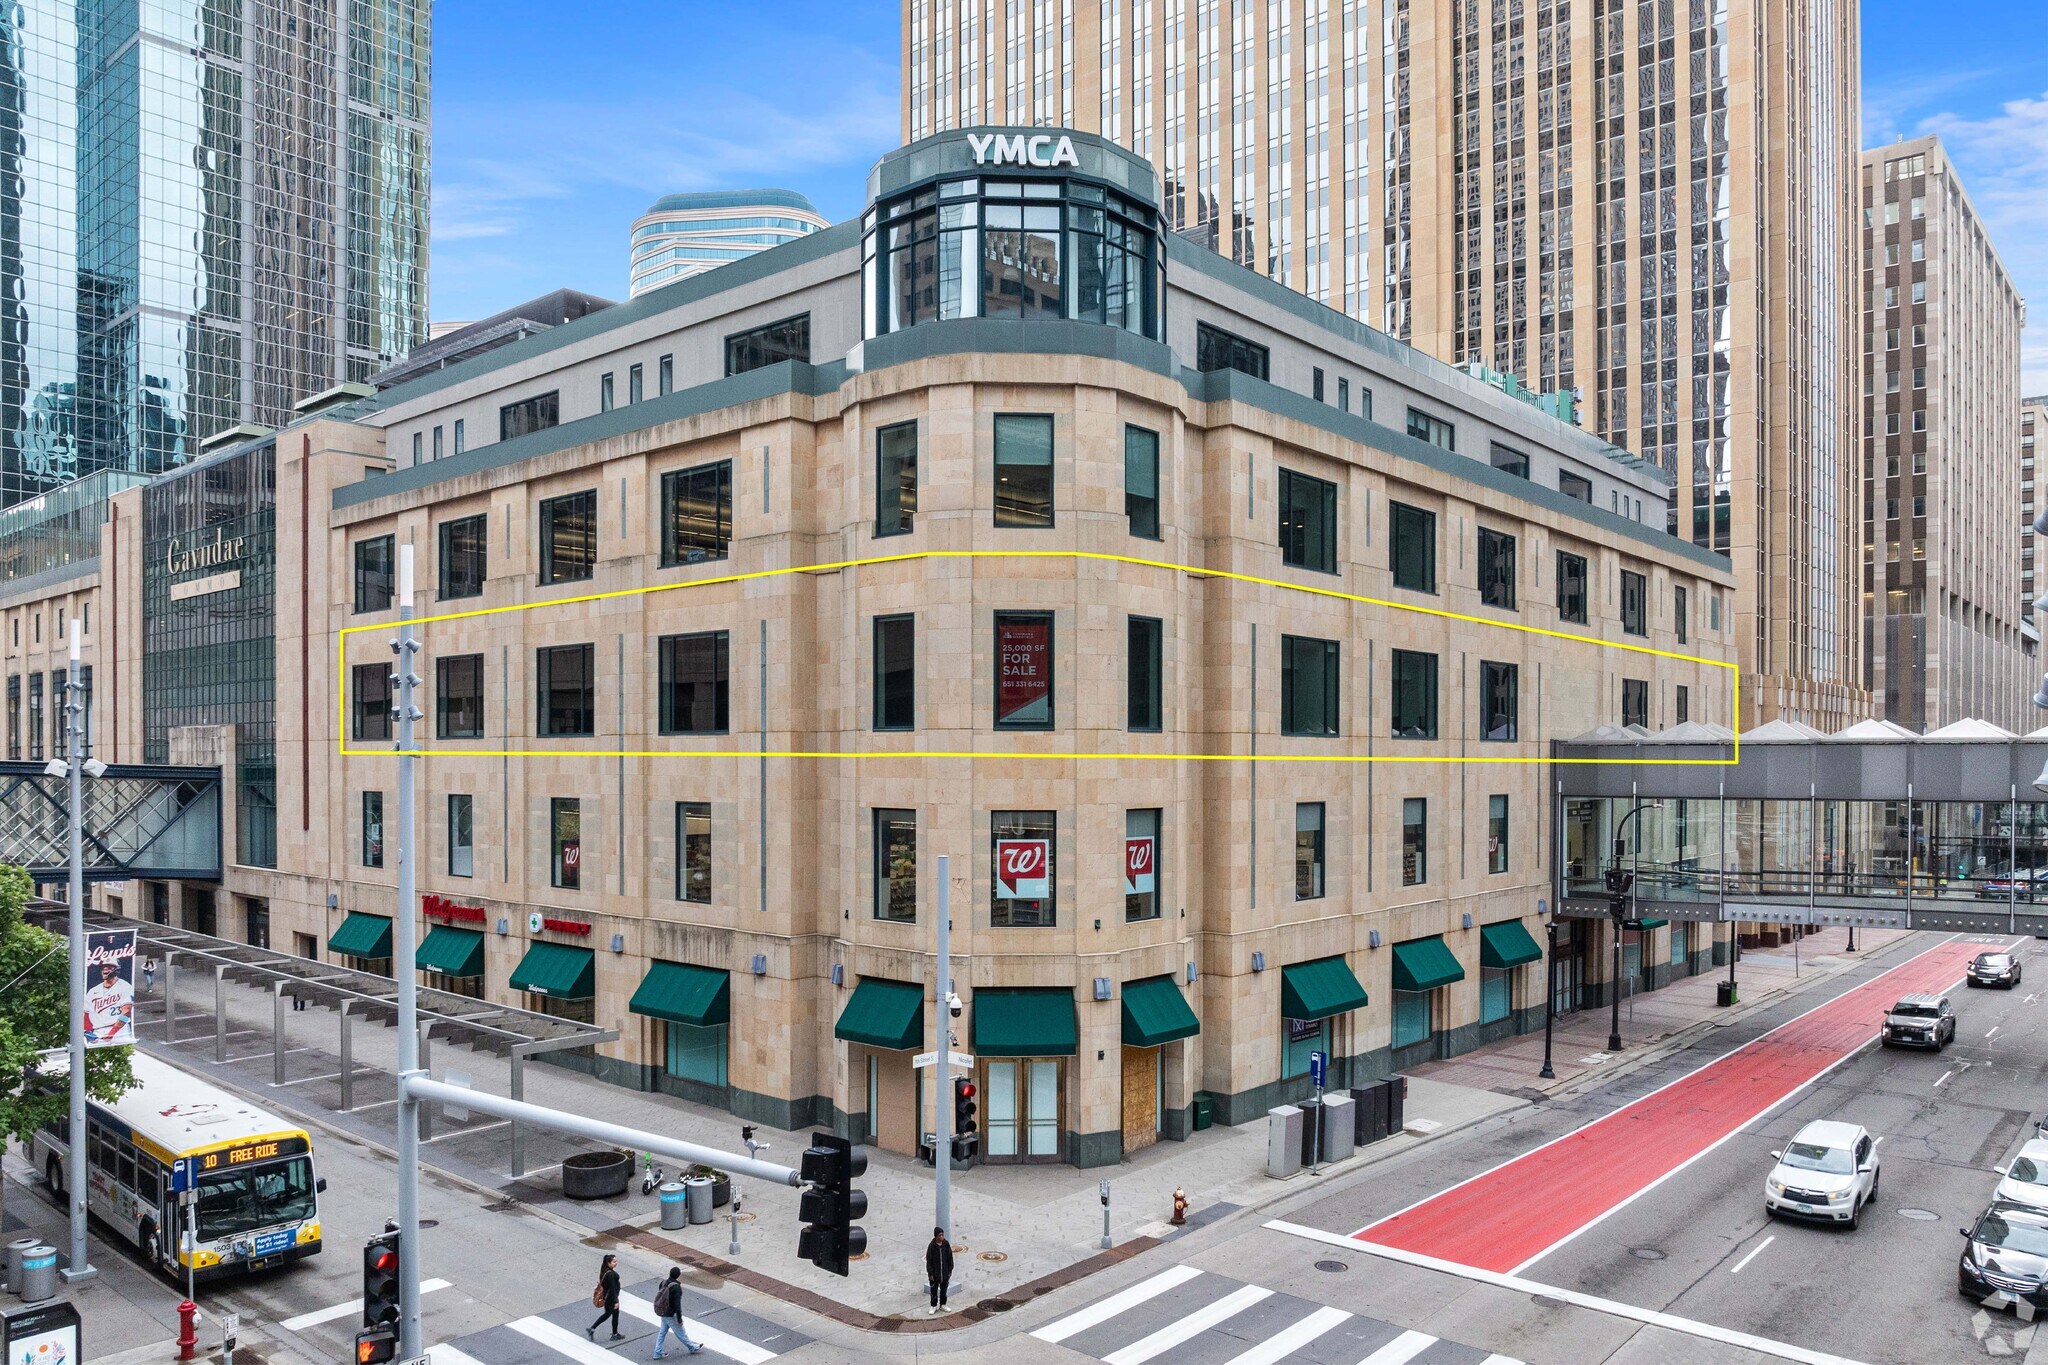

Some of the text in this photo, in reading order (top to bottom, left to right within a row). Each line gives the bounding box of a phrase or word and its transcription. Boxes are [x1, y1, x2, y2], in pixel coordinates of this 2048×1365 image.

[967, 133, 1079, 167] YMCA
[1003, 653, 1030, 663] FOR
[1003, 665, 1037, 676] SALE
[565, 847, 579, 865] W
[1004, 846, 1042, 874] W
[1129, 843, 1151, 870] W
[422, 895, 487, 924] Walgreens
[86, 943, 136, 966] Lewis
[91, 993, 121, 1014] Twins
[110, 1006, 122, 1017] 23
[205, 1142, 279, 1169] 10 FREE RIDE
[213, 1243, 231, 1252] 1503
[256, 1232, 288, 1244] Apply today
